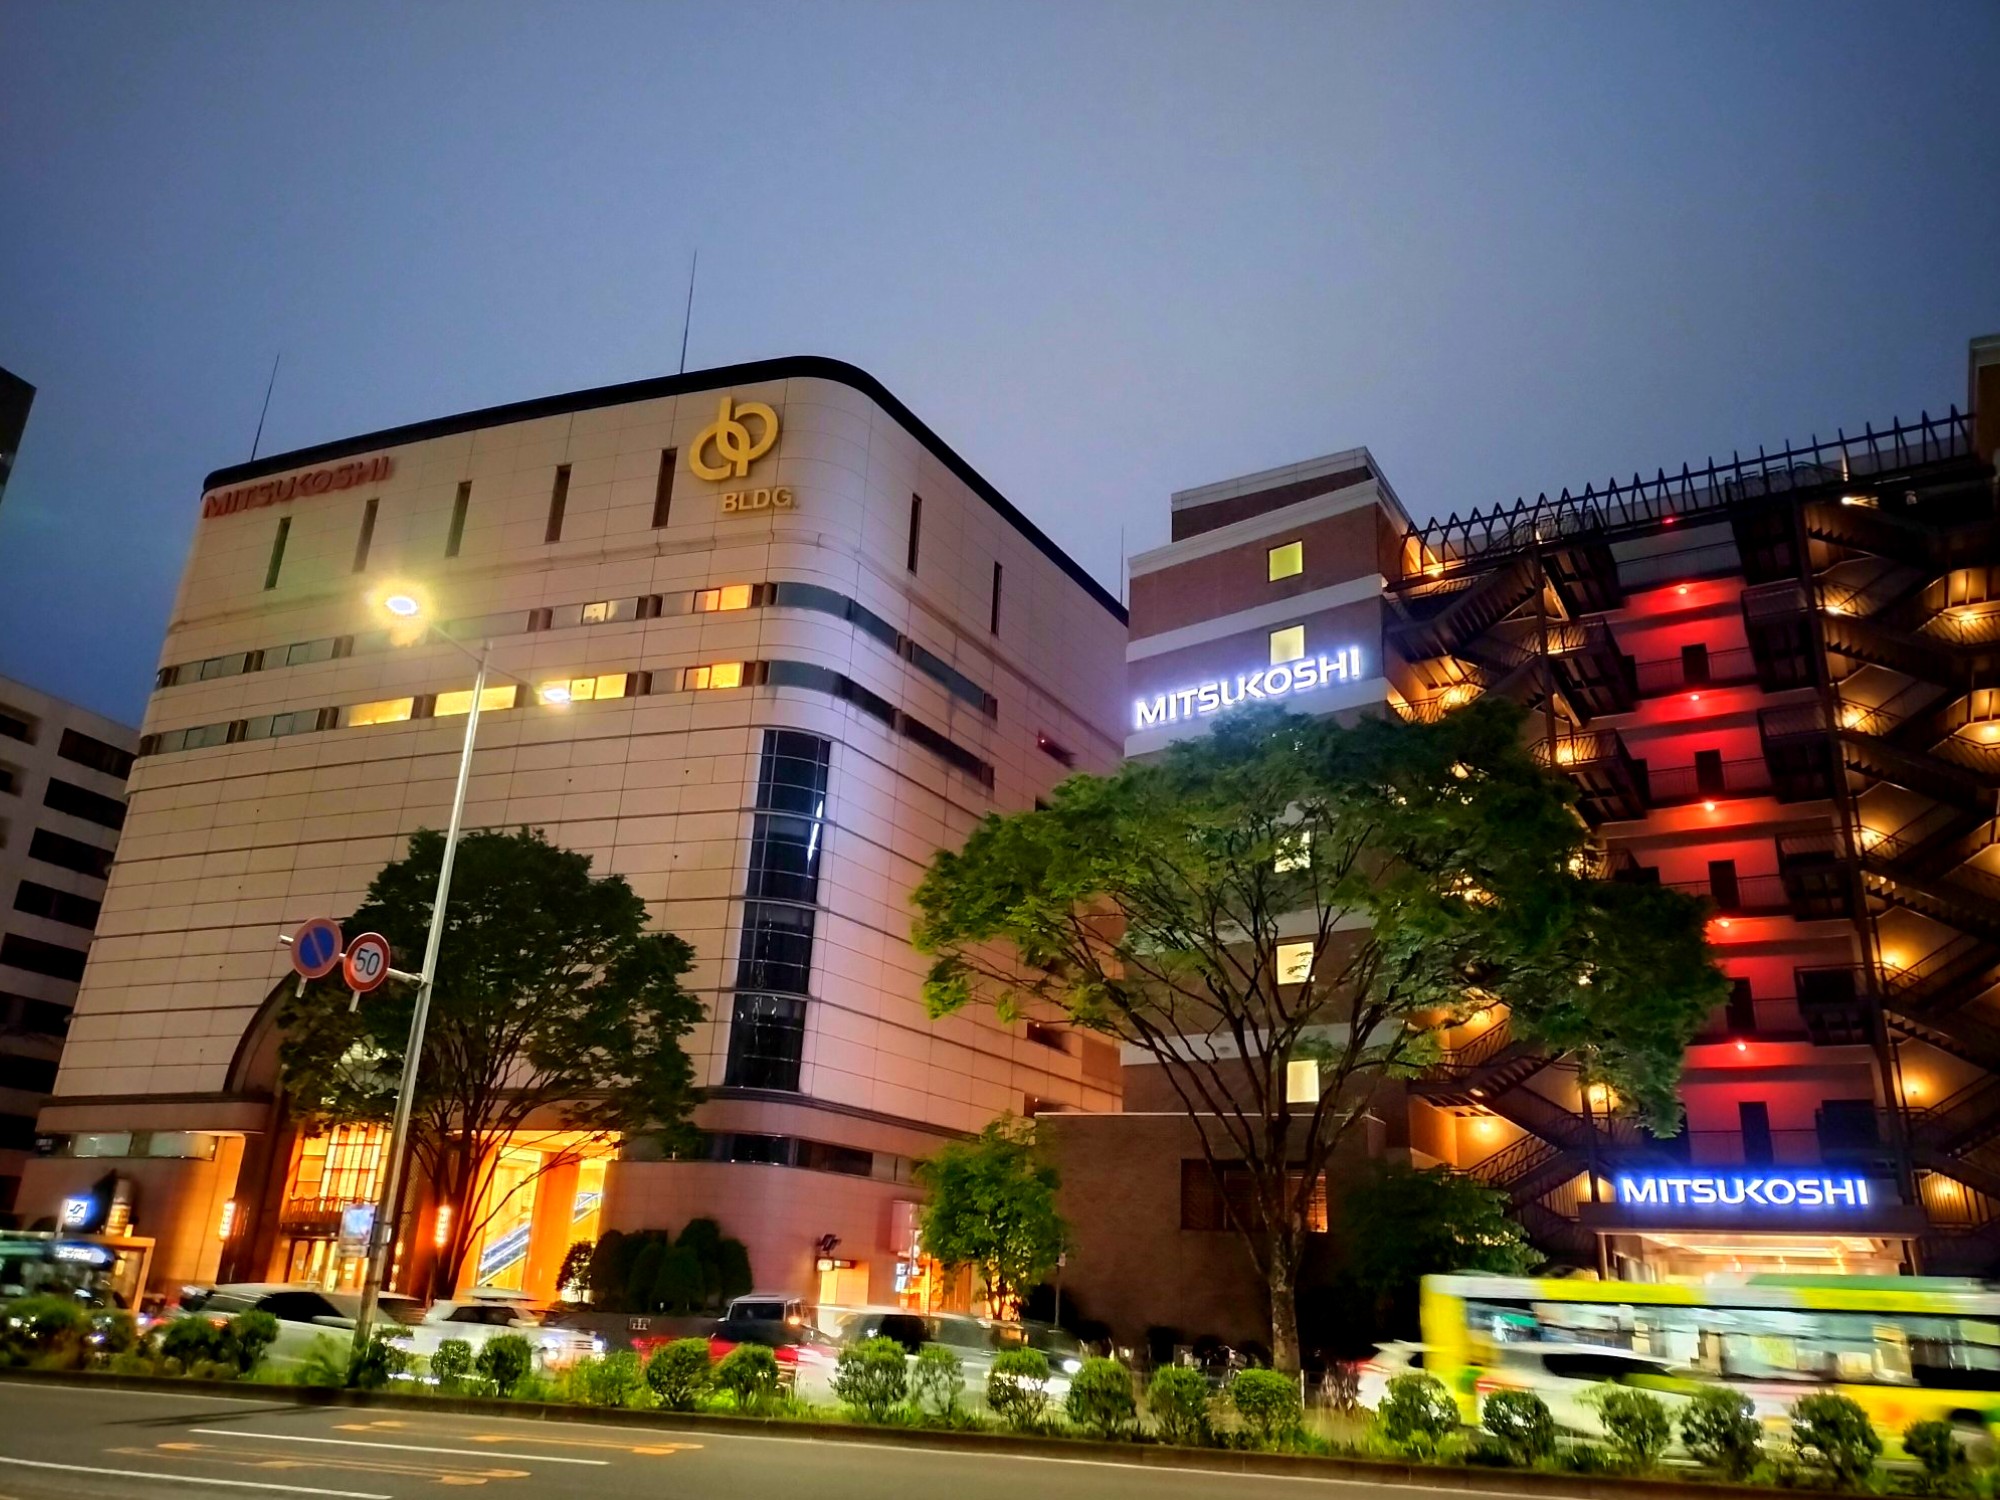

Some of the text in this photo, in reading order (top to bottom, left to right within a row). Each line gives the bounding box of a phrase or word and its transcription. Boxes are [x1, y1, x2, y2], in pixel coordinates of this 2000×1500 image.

[203, 456, 391, 518] MITSUKOSHI
[1135, 647, 1361, 730] MITSUKOSHI
[354, 947, 381, 976] 50
[1621, 1178, 1869, 1206] MITSUKOSHI
